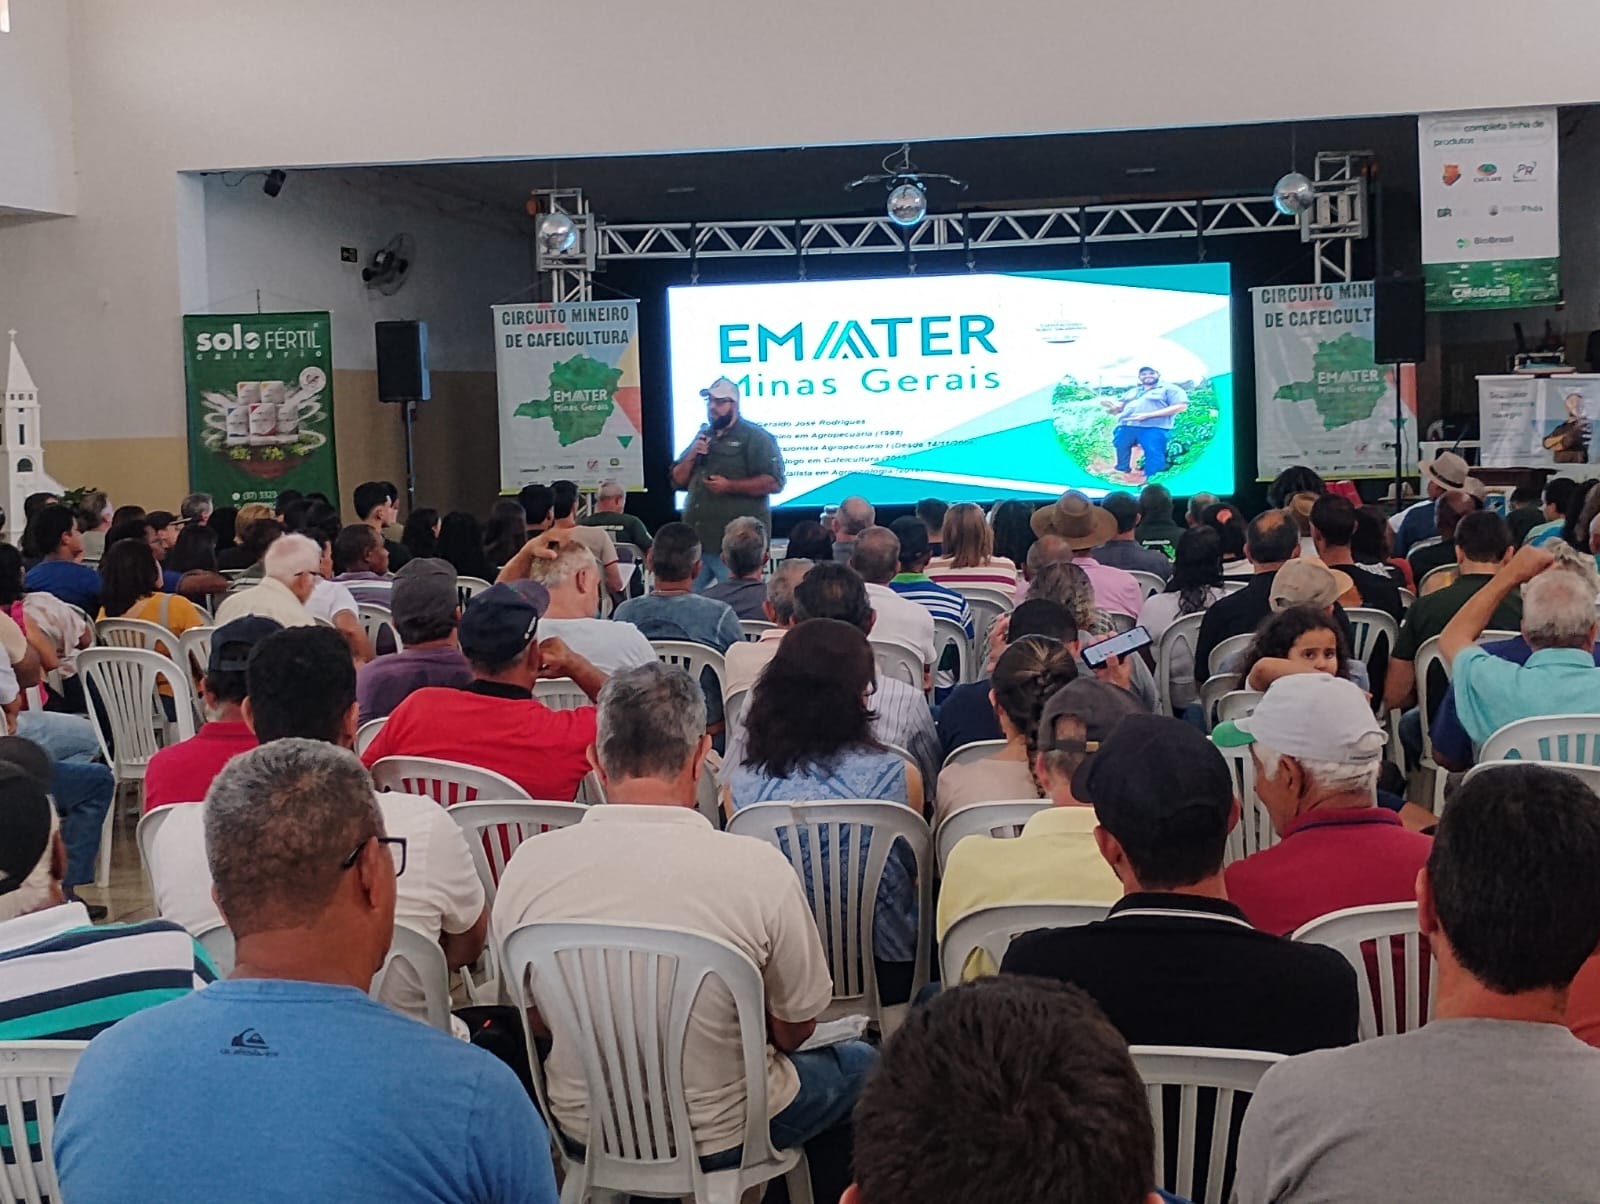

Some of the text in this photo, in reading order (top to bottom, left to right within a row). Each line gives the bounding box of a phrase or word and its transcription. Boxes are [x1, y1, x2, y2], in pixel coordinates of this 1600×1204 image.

[1532, 120, 1544, 128] de
[1261, 286, 1333, 304] CIRCUITO
[502, 306, 629, 326] CIRCUITO MINEIRO
[1265, 308, 1373, 328] DE CAFEICULT
[196, 323, 321, 352] solo FÉRTIL
[505, 329, 629, 348] DE CAFEICULTURA
[860, 365, 1000, 393] Gerais
[795, 419, 816, 427] José
[819, 418, 866, 427] Rodrigues
